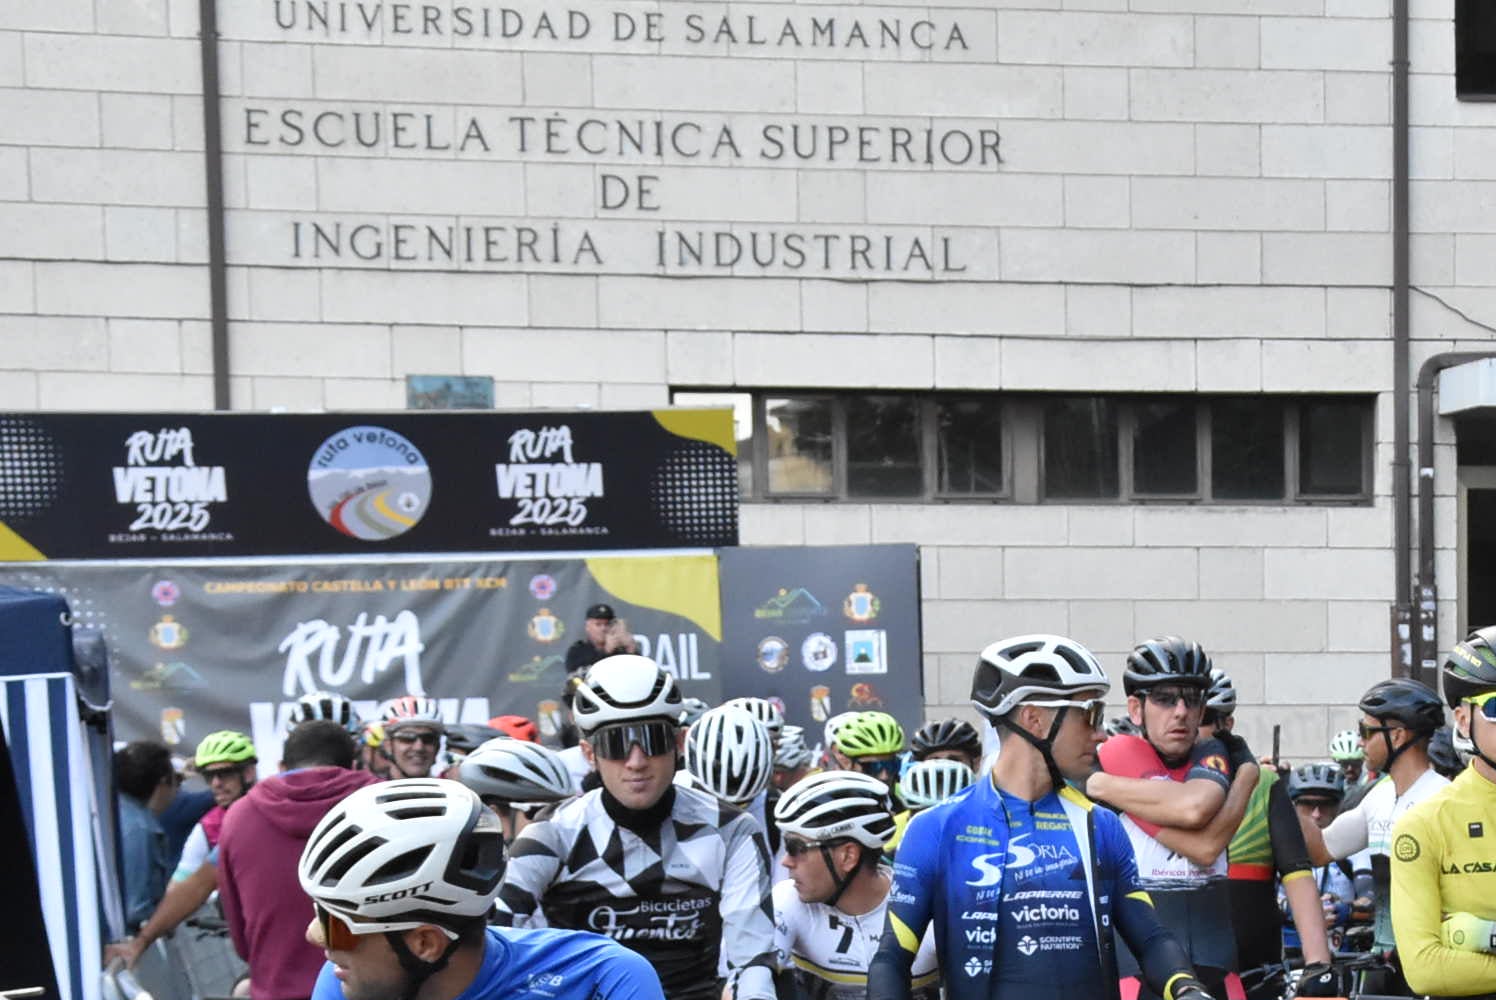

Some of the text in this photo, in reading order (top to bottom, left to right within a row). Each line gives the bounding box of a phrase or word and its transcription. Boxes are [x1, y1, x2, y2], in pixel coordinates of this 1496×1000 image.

[274, 0, 969, 51] UNIVERSIDAD DE SALAMANCA
[244, 108, 1005, 166] ESCUELA TÉCNICA SUPERIOR
[601, 174, 661, 211] DE
[292, 220, 967, 272] INGENIERÍA INDUSTRIAL
[125, 427, 194, 466] RUTA
[318, 431, 420, 467] ruta vetona
[508, 425, 574, 463] RUTA
[112, 466, 228, 504] VETONA
[495, 462, 604, 498] VETONA
[129, 502, 210, 532] 2025
[509, 497, 588, 526] 2025
[278, 609, 425, 698] RUTA
[1440, 862, 1461, 875] LA
[362, 880, 434, 905] SCOTT
[640, 897, 712, 914] Bicicletas
[1003, 890, 1084, 902] LAPIERRE
[1011, 903, 1080, 922] victoria
[829, 914, 855, 954] 7
